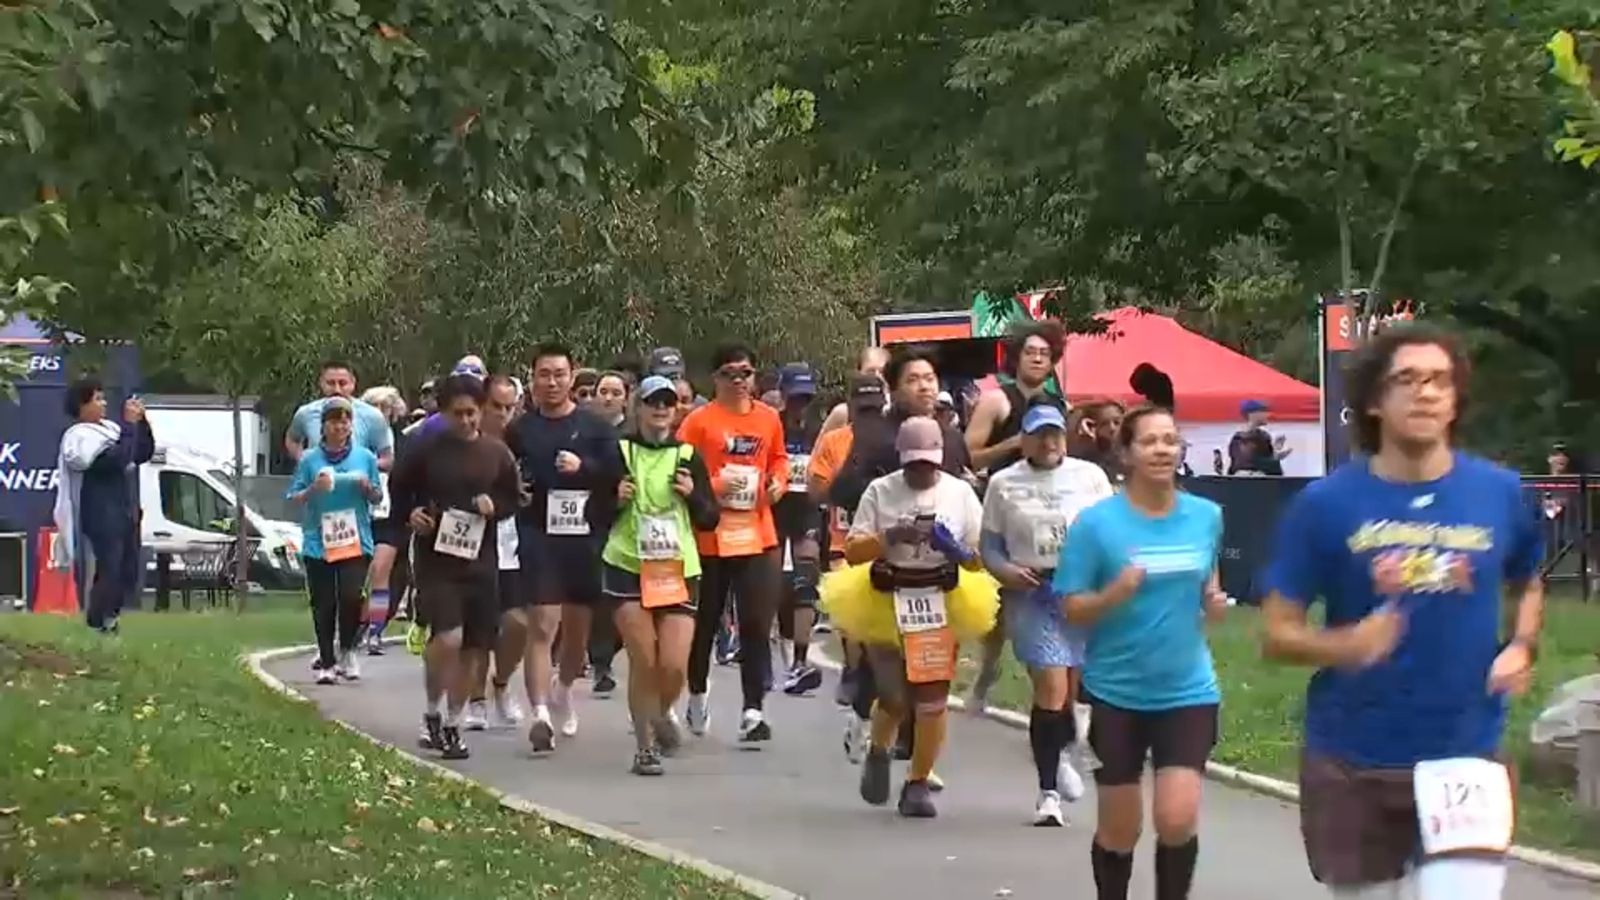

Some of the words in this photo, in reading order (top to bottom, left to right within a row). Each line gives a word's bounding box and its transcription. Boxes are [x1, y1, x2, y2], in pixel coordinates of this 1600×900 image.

[561, 501, 577, 515] 50
[453, 521, 470, 537] 52
[907, 599, 931, 613] 101
